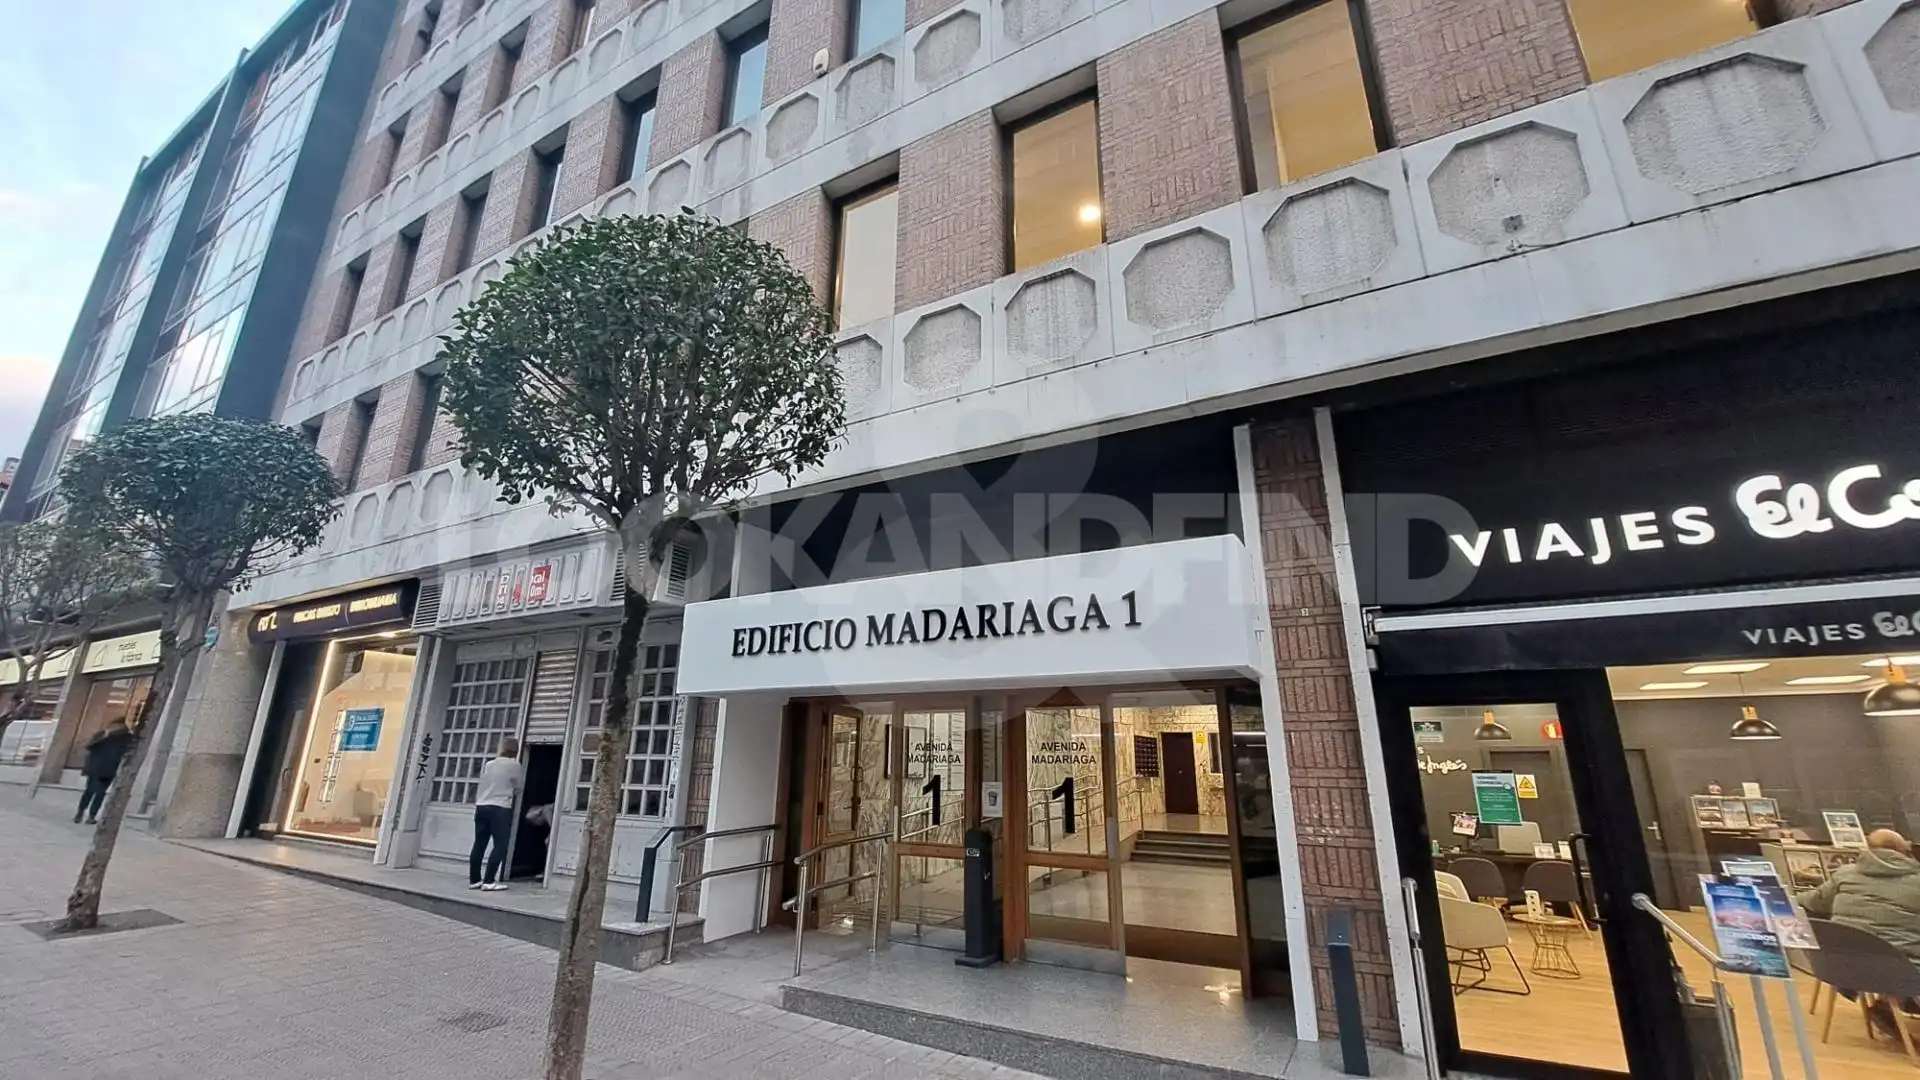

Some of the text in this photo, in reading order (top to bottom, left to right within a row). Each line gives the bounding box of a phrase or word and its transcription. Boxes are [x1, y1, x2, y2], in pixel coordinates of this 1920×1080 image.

[1448, 505, 1715, 567] VIAJES
[732, 590, 1142, 657] EDIFICIO MADARIAGA 1
[1742, 623, 1866, 647] VIAJES
[907, 754, 961, 764] MADARIAGA
[914, 742, 953, 752] AVENIDA
[1040, 742, 1086, 752] AVENIDA
[1031, 754, 1096, 765] MADARIAGA
[922, 775, 941, 826] 1
[1051, 777, 1075, 834] 1
